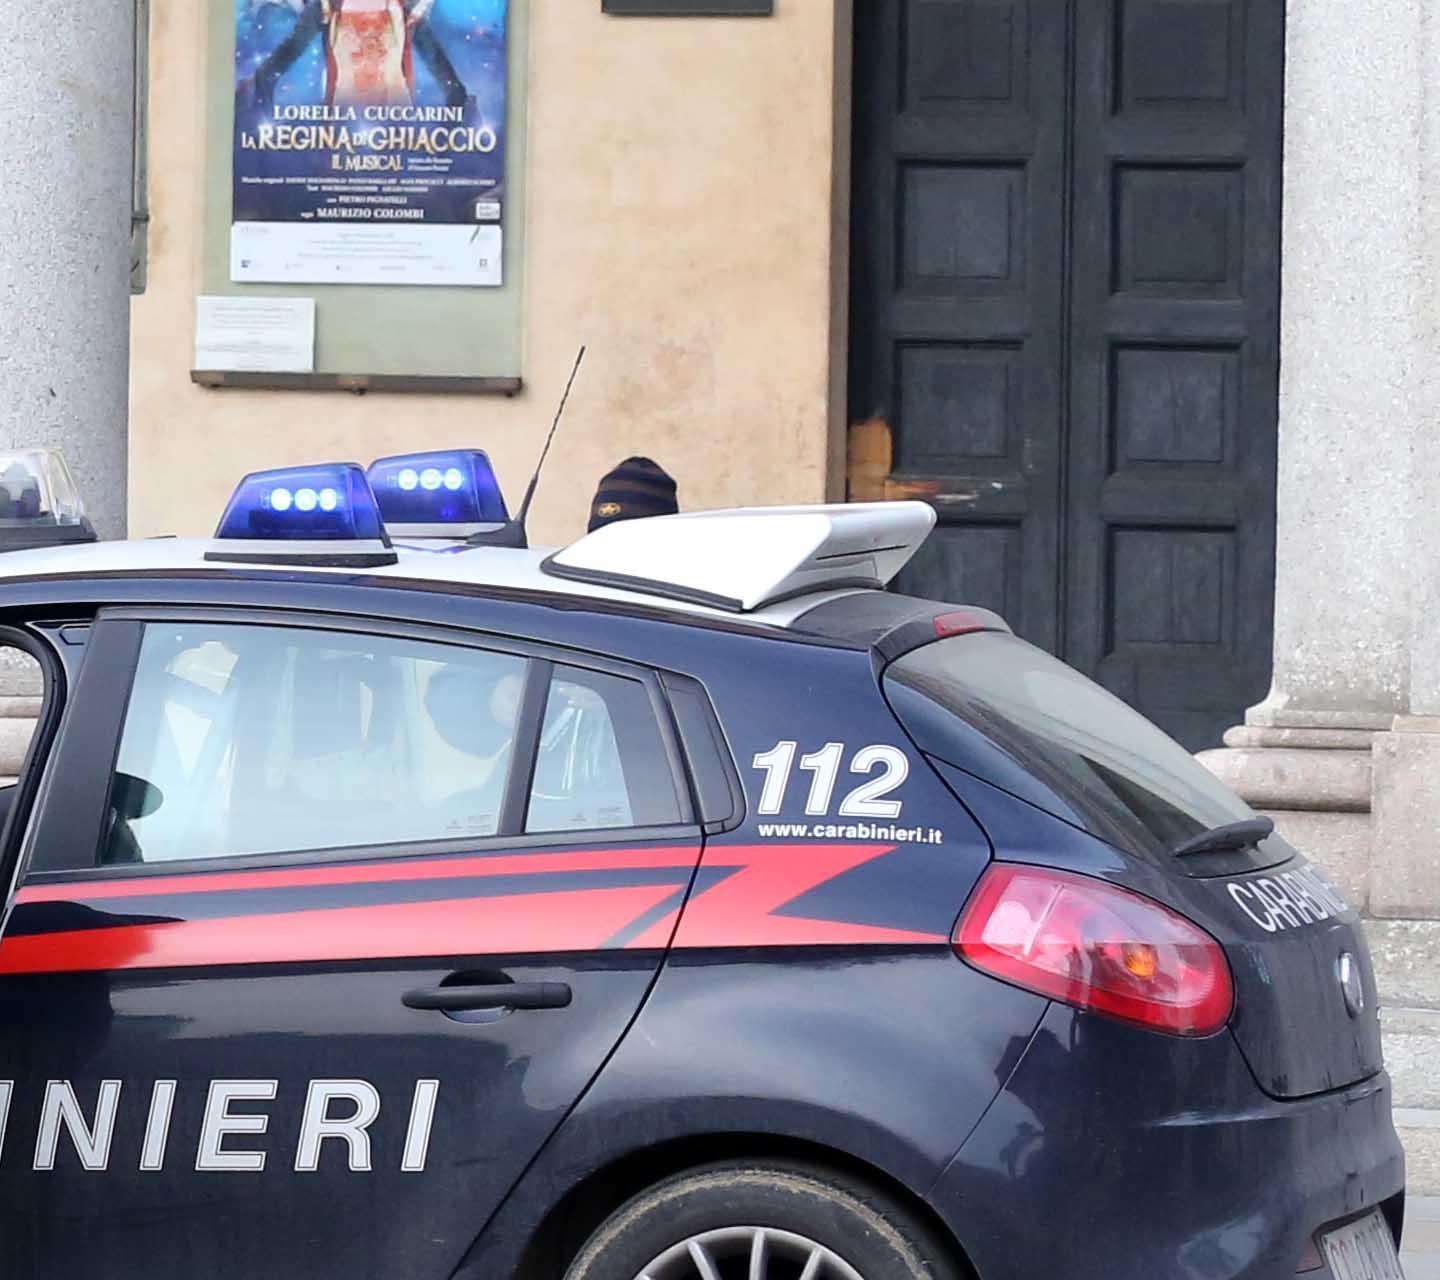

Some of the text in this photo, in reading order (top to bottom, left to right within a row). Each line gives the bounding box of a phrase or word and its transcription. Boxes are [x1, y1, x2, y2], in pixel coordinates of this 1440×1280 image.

[273, 105, 464, 122] LORELLA CUCCARINI
[241, 124, 497, 154] LA REGINA DI GHIACCIO
[331, 154, 343, 170] IL
[344, 154, 404, 171] MUSICAL
[317, 208, 371, 219] MAURIZIO
[373, 208, 425, 220] COLOMBI
[752, 740, 909, 819] 112
[758, 823, 943, 844] www.carabinieri.it
